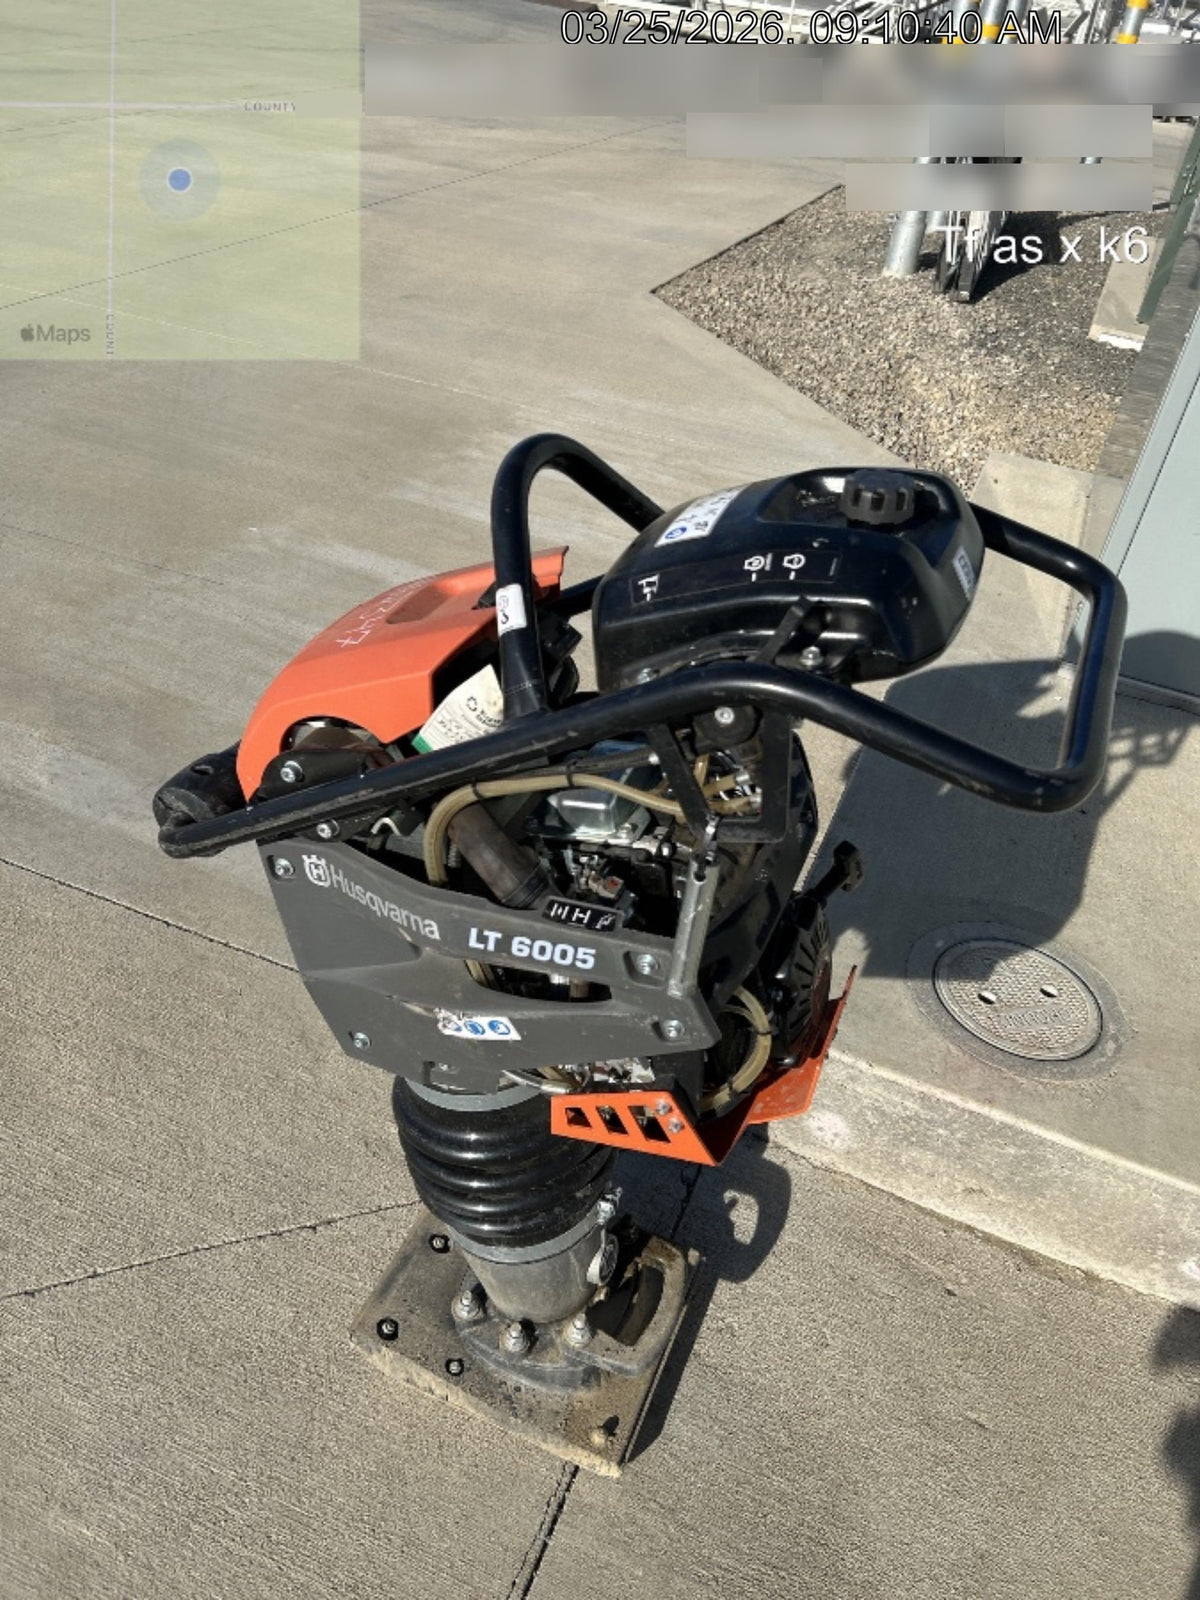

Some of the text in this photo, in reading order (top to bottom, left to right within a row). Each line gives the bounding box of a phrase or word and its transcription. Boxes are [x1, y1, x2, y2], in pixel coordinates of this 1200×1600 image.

[329, 863, 442, 941] Husqvarna
[468, 927, 597, 970] LT 6005
